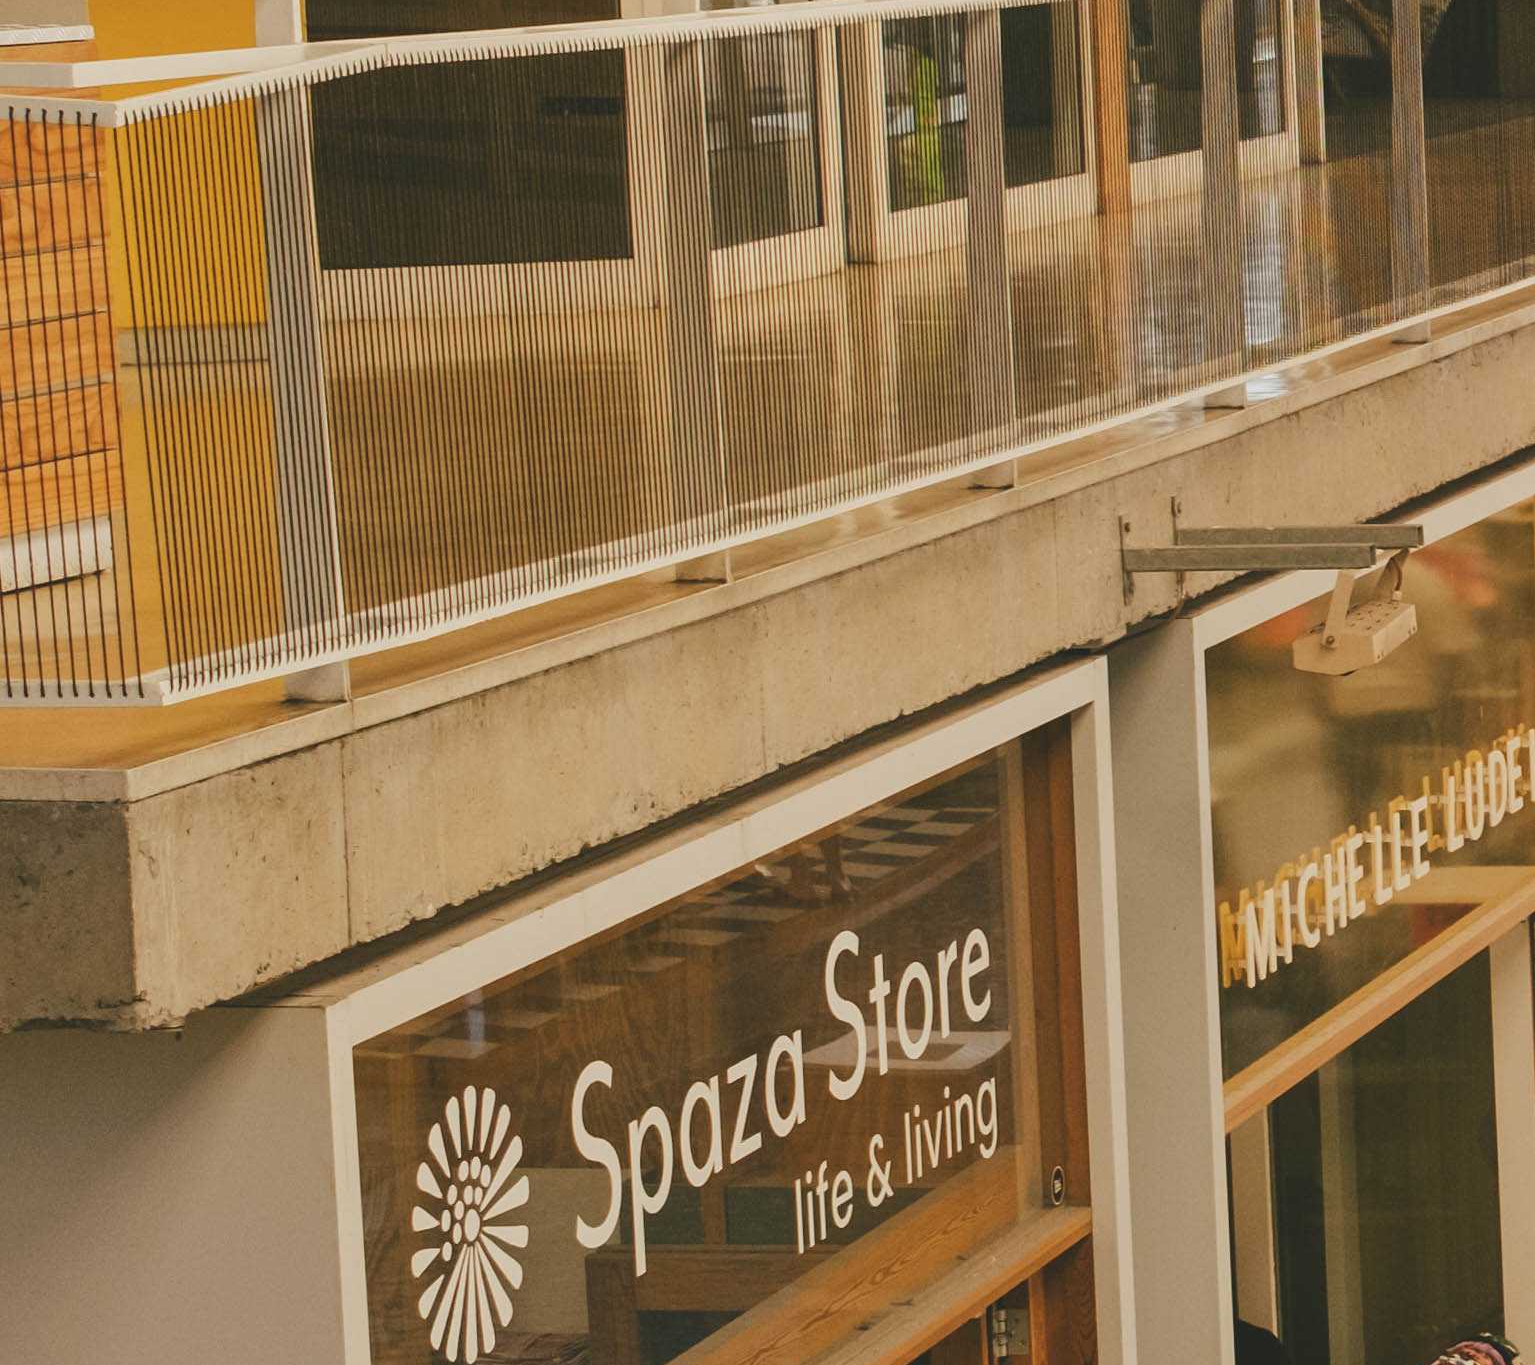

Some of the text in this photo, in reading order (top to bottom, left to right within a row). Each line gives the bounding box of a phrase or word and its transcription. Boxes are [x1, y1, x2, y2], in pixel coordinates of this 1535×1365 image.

[1245, 795, 1431, 989] MICHELLE
[571, 928, 992, 1277] Spaza Store
[794, 1077, 998, 1254] life & living
